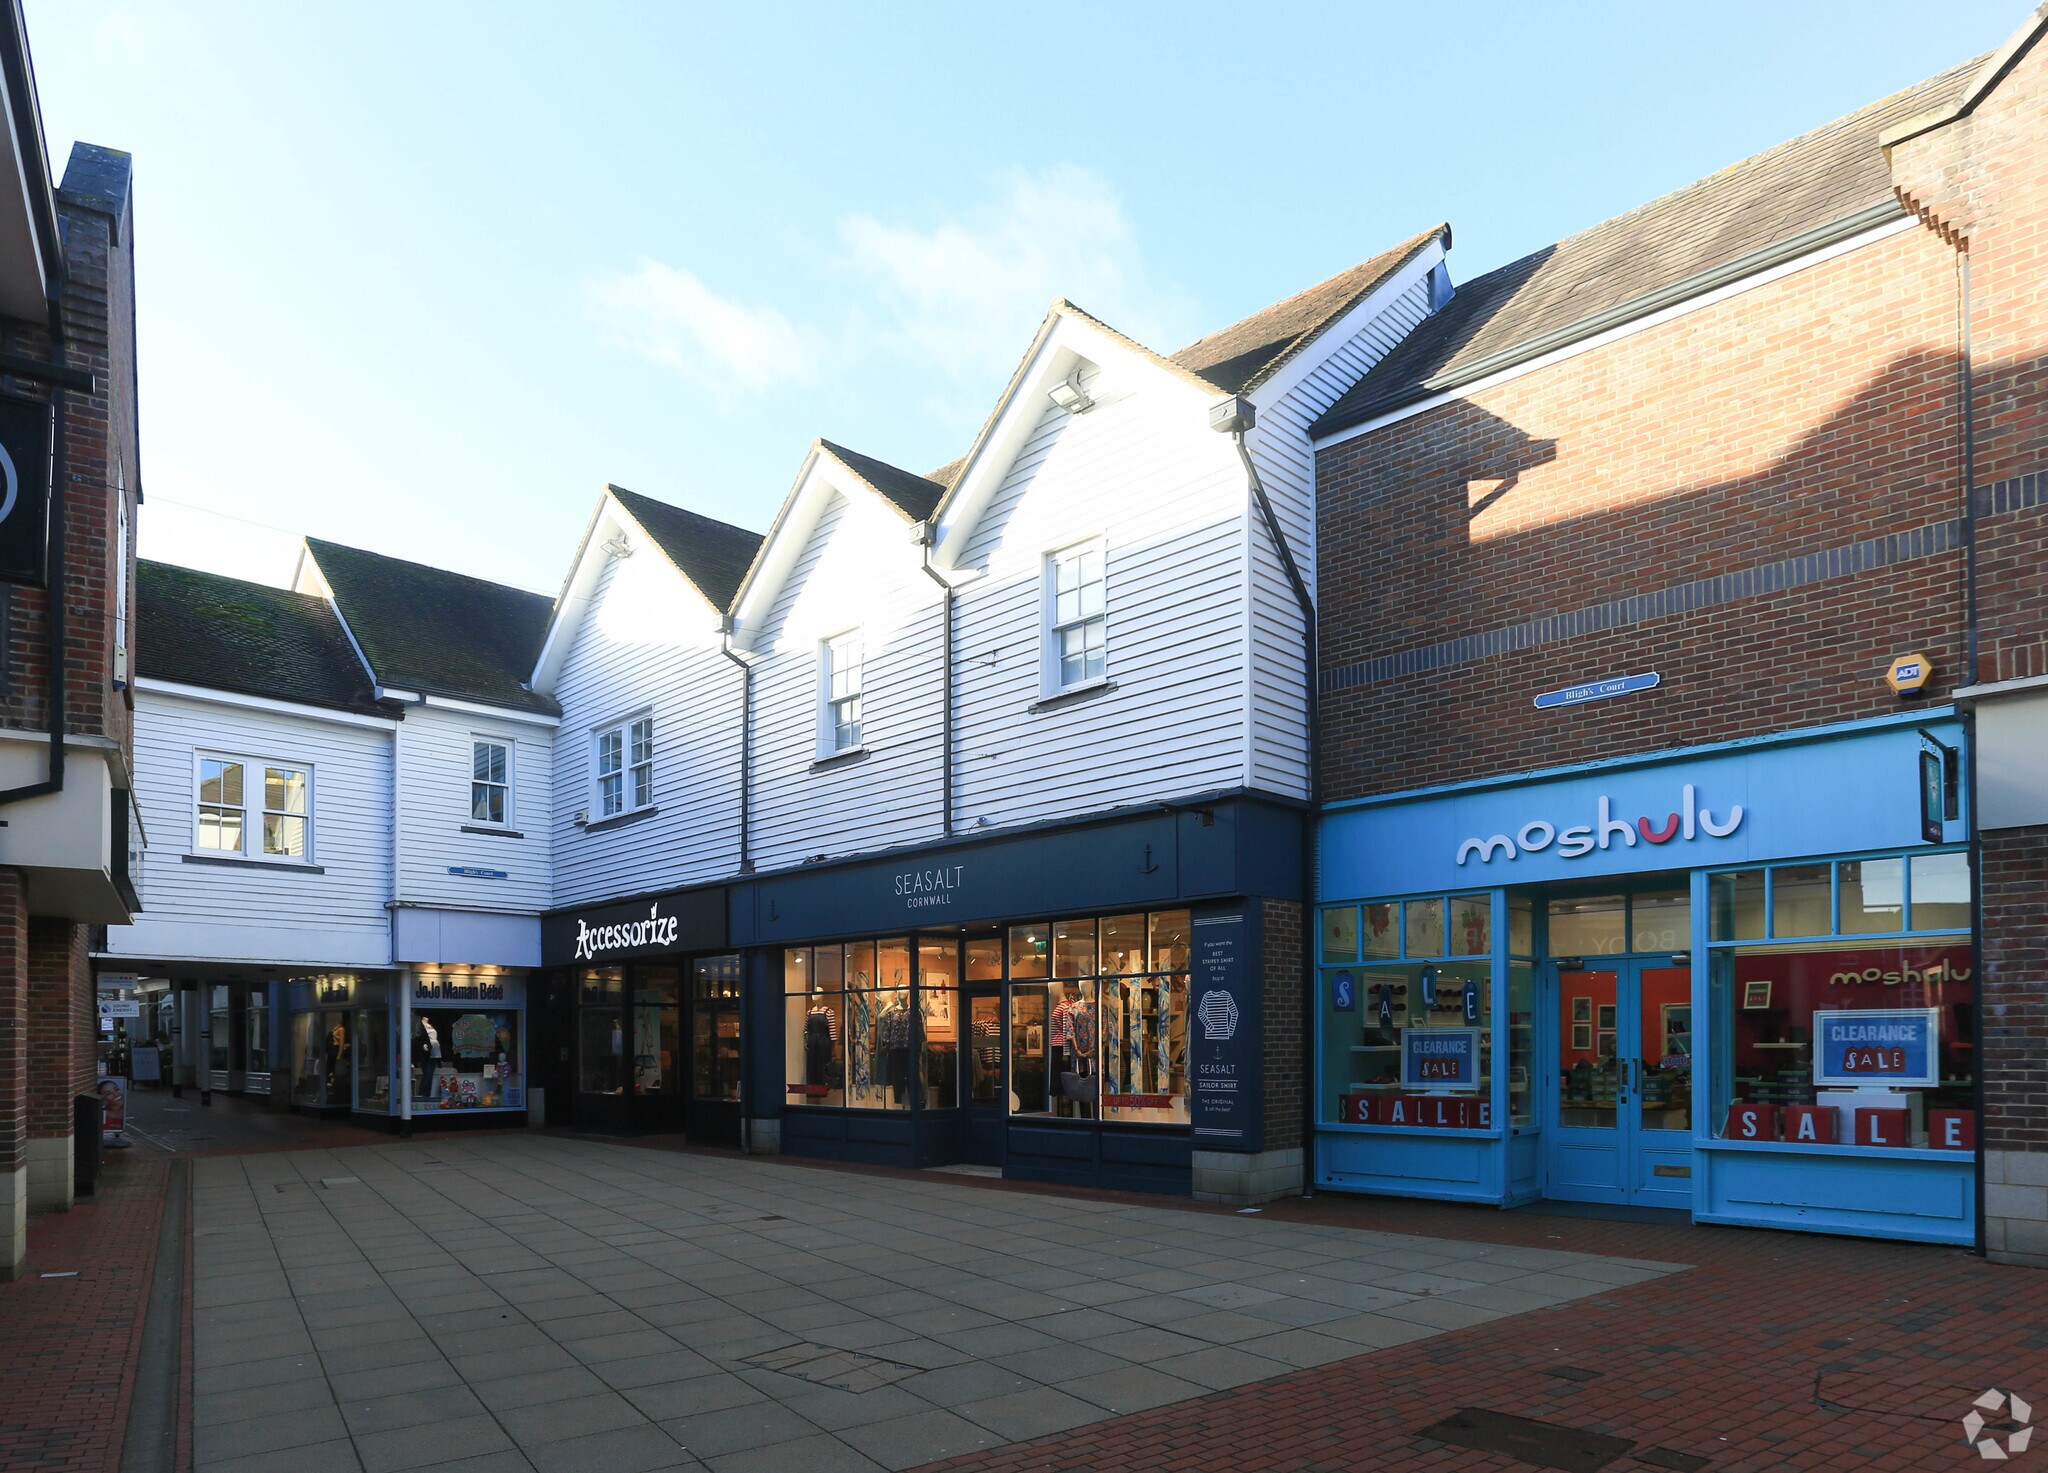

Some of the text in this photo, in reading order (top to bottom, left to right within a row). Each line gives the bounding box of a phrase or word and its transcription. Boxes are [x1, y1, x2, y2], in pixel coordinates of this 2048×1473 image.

[1897, 667, 1919, 678] ADT
[1565, 681, 1625, 700] Bligh's Court
[1456, 783, 1743, 865] moshulu
[895, 865, 964, 896] SEASALT
[907, 893, 951, 909] CORNWALL
[575, 902, 678, 960] Accessorize
[1829, 958, 1971, 986] moshulu
[416, 981, 504, 1000] JoJo Maman Bébé
[1831, 1025, 1917, 1041] CLEARANCE
[1413, 1041, 1467, 1054] CLEARANCE
[1200, 1064, 1235, 1074] SEASALT
[1422, 1062, 1456, 1076] SALE
[1845, 1052, 1901, 1070] SALE
